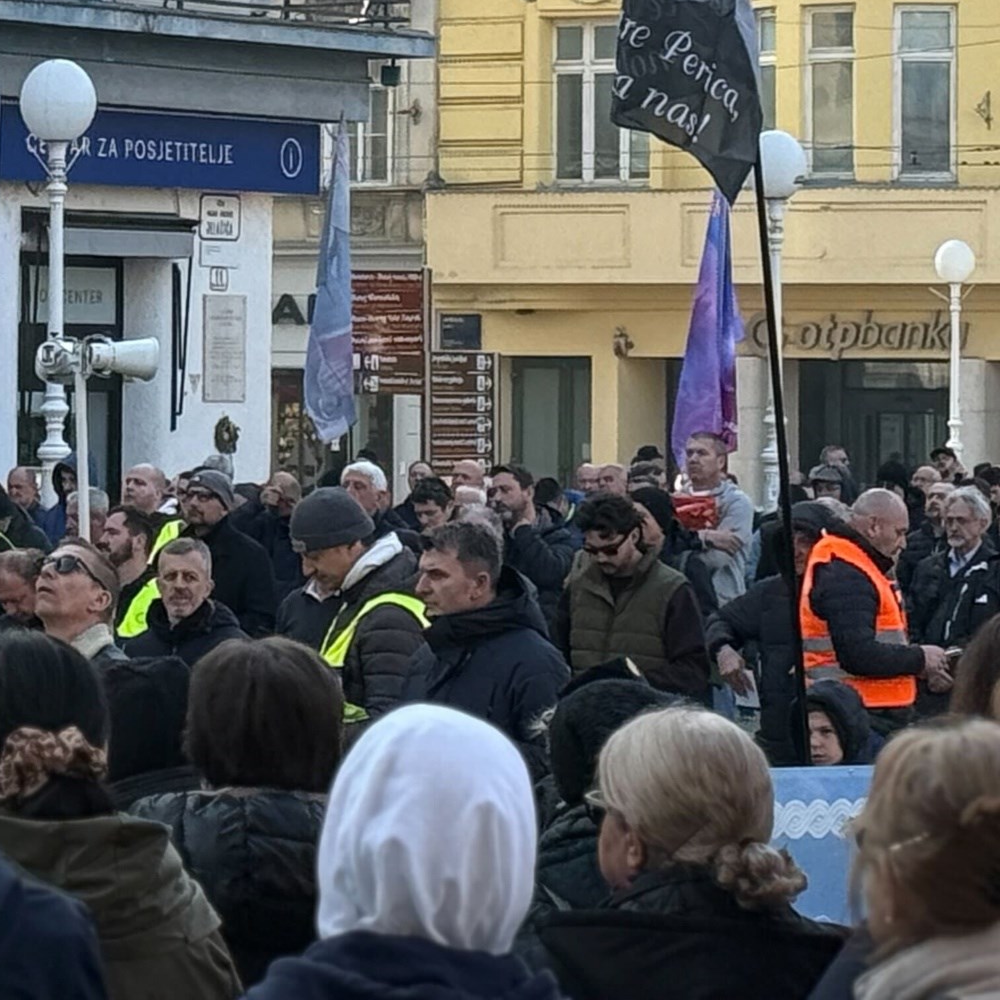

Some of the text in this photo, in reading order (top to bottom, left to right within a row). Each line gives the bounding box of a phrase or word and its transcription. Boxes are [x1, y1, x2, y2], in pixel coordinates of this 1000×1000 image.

[659, 30, 739, 123] Perica,
[641, 87, 711, 143] nas!
[97, 138, 118, 158] ZA
[125, 139, 234, 165] POSJETITELJE
